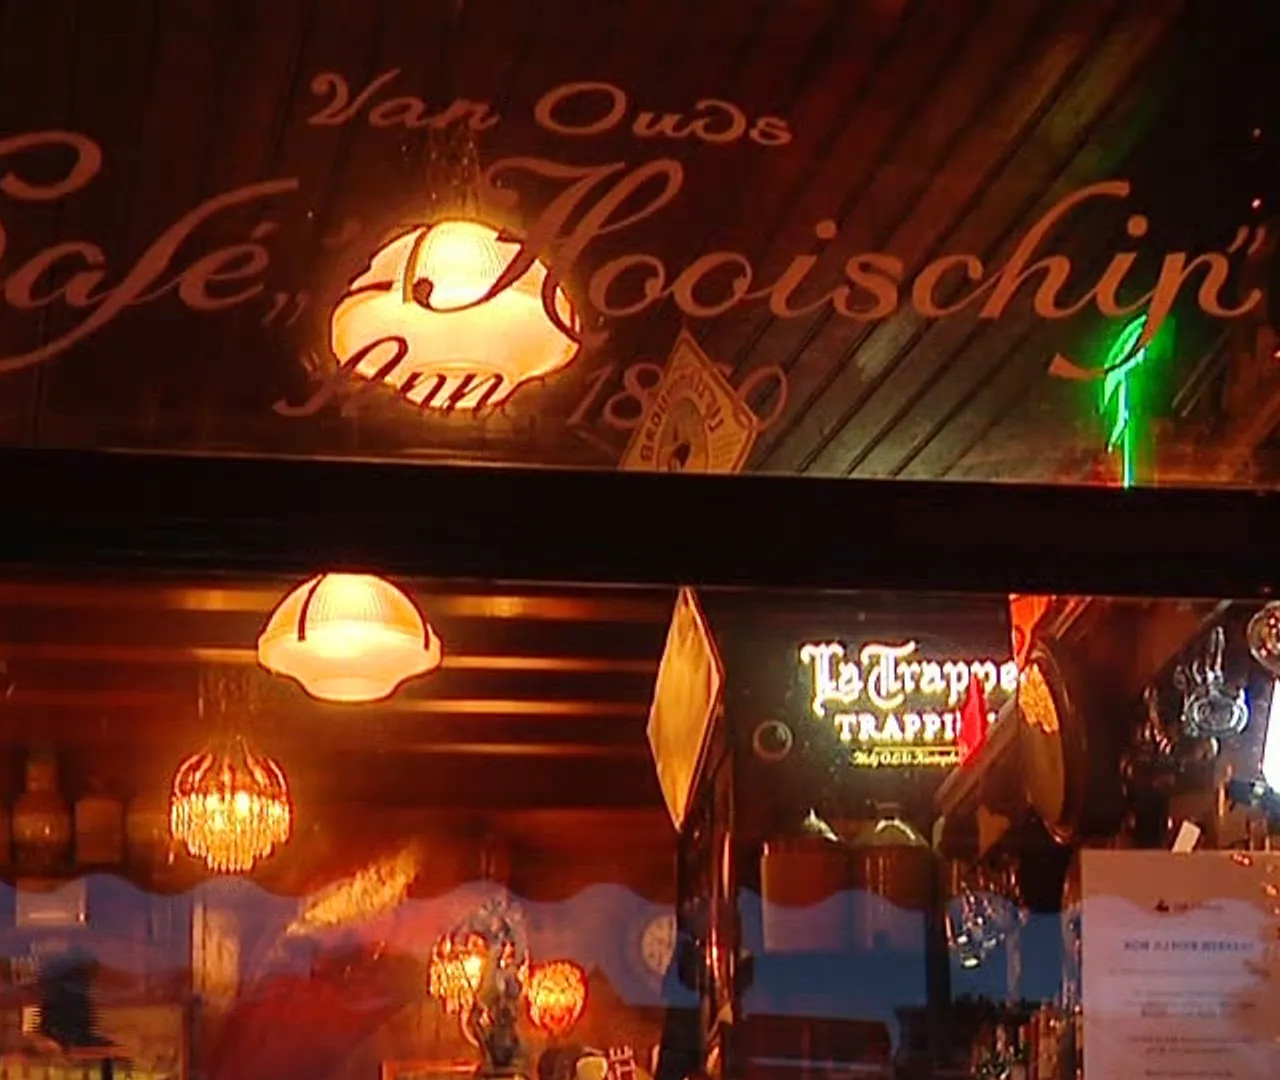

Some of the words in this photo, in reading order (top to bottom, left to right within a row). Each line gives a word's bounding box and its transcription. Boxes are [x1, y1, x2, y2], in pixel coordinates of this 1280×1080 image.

[309, 70, 500, 134] Van
[534, 81, 795, 148] Ouds
[564, 360, 790, 432] 180
[800, 642, 864, 716] La
[834, 711, 997, 741] TRAPPI
